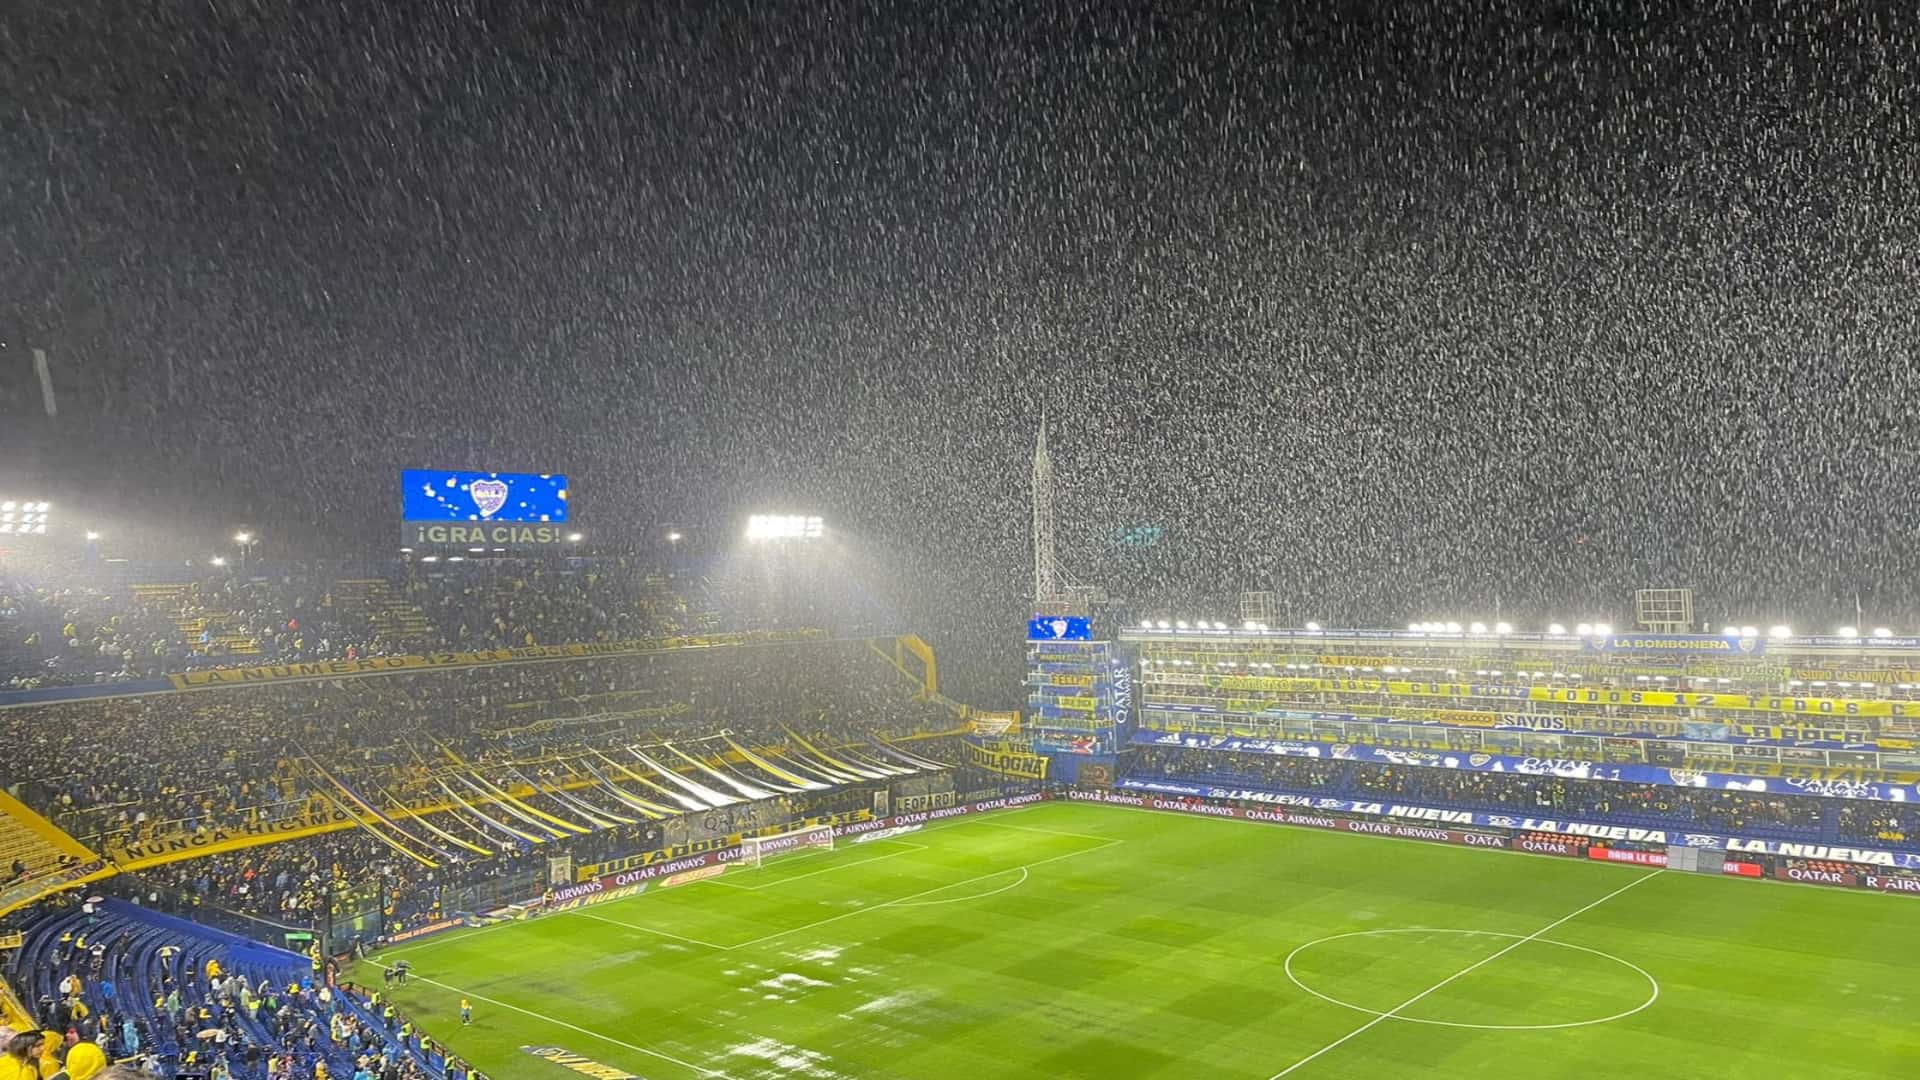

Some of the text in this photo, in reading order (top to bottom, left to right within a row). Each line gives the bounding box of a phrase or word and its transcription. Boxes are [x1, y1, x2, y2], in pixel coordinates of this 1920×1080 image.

[1614, 639, 1729, 649] LA BOMBONERA
[182, 671, 226, 686] LA
[240, 657, 406, 680] NUMERO
[1114, 668, 1128, 723] QATAR
[1547, 689, 1642, 703] TODOS
[1408, 750, 1440, 761] Shop
[1523, 757, 1591, 769] QATAR
[976, 792, 1042, 812] QATAR AIRWAYS
[1069, 790, 1143, 805] QATAR AIRWAYS
[895, 805, 968, 826] QATAR AIRWAYS
[1153, 800, 1234, 816] QATAR AIRWAYS
[1351, 801, 1383, 814] LA
[1387, 804, 1473, 824] NUEVA
[1246, 810, 1336, 828] QATAR AIRWAYS
[809, 828, 843, 842] QATAR
[845, 820, 885, 834] AIRWAYS
[1349, 822, 1449, 841] QATAR AIRWAYS
[1464, 834, 1503, 847] QATA
[1521, 818, 1557, 832] LA
[1566, 822, 1667, 844] NUEVA
[127, 831, 230, 860] NUNCA
[718, 836, 799, 860] QATAR AIRWAYS
[1522, 840, 1567, 854] QATAR
[1726, 837, 1768, 852] LA
[1778, 842, 1896, 867] NUEVA
[615, 867, 656, 885] QATAR
[658, 856, 706, 875] AIRWAYS
[1788, 868, 1842, 883] QATAR
[553, 882, 603, 901] AIRWAYS
